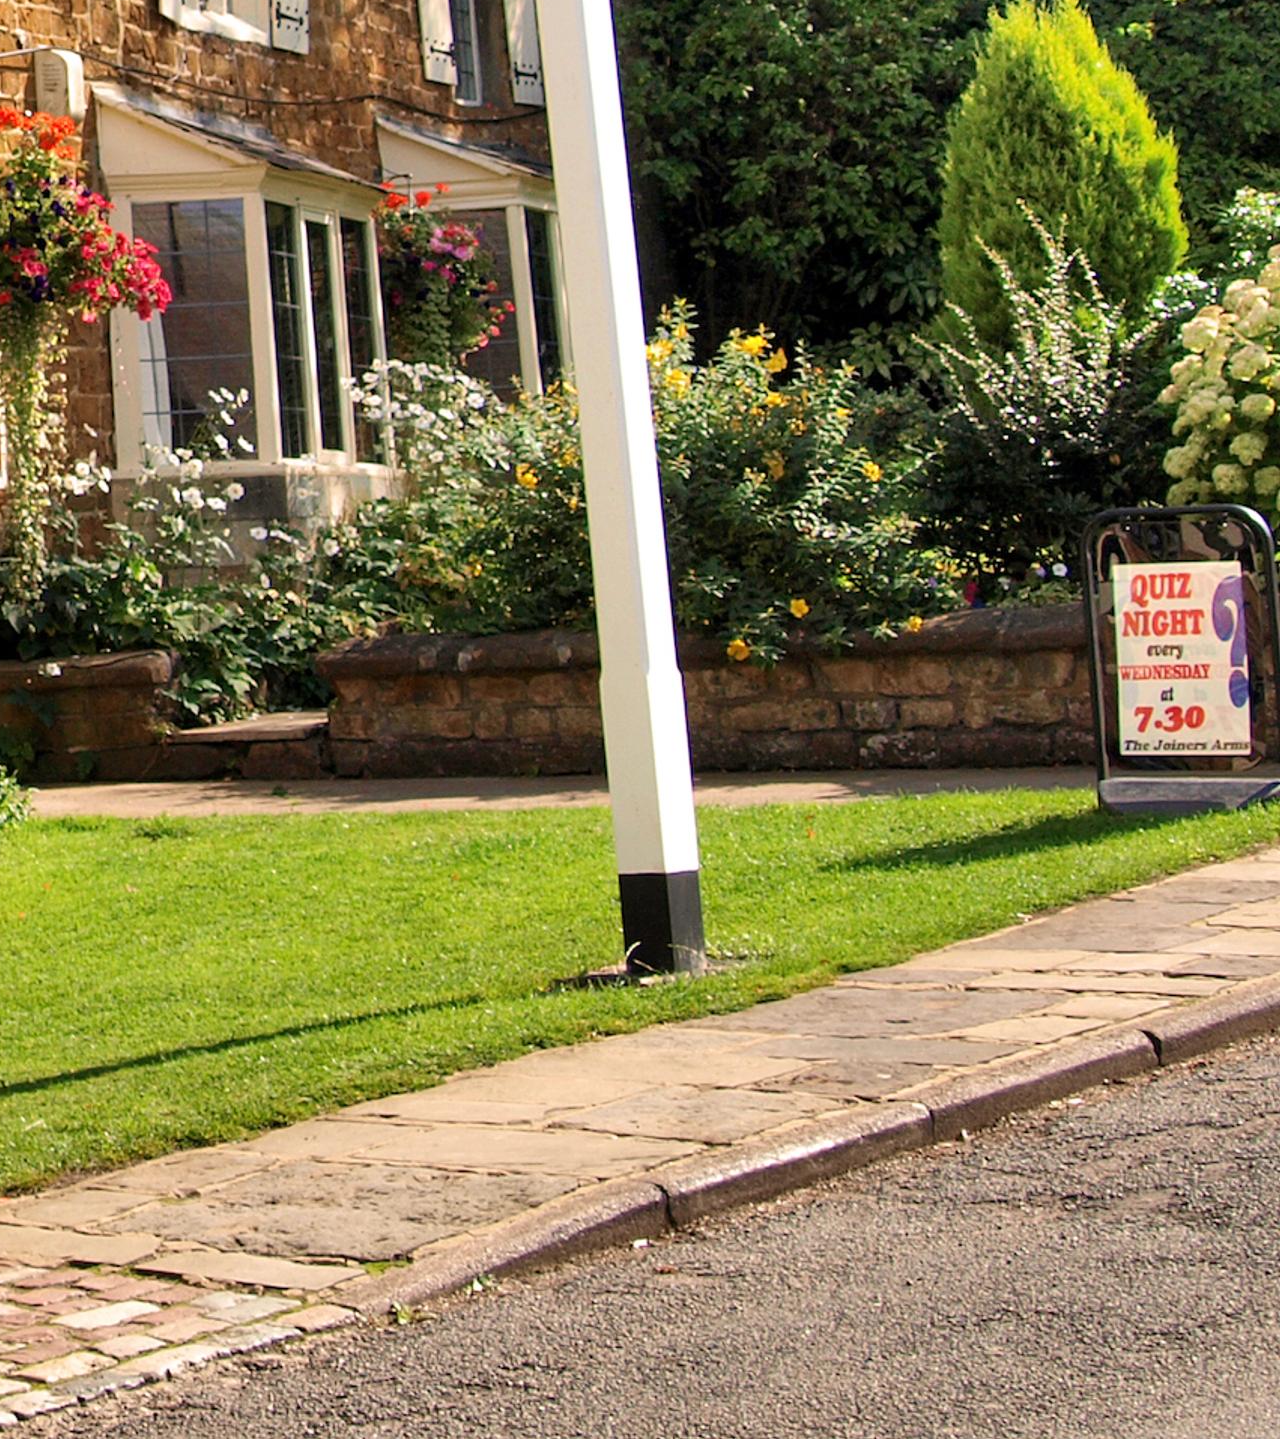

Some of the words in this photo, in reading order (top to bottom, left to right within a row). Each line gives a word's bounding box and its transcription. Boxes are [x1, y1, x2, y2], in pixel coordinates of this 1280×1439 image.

[1131, 573, 1191, 607] QUIZ
[1122, 609, 1204, 637] NIGHT
[1147, 644, 1183, 660] every
[1119, 664, 1210, 680] WEDNESDAY
[1161, 686, 1174, 701] at
[1134, 705, 1205, 733] 7.30
[1125, 740, 1150, 751] The
[1153, 740, 1208, 751] Joiners
[1211, 740, 1249, 751] Arms
